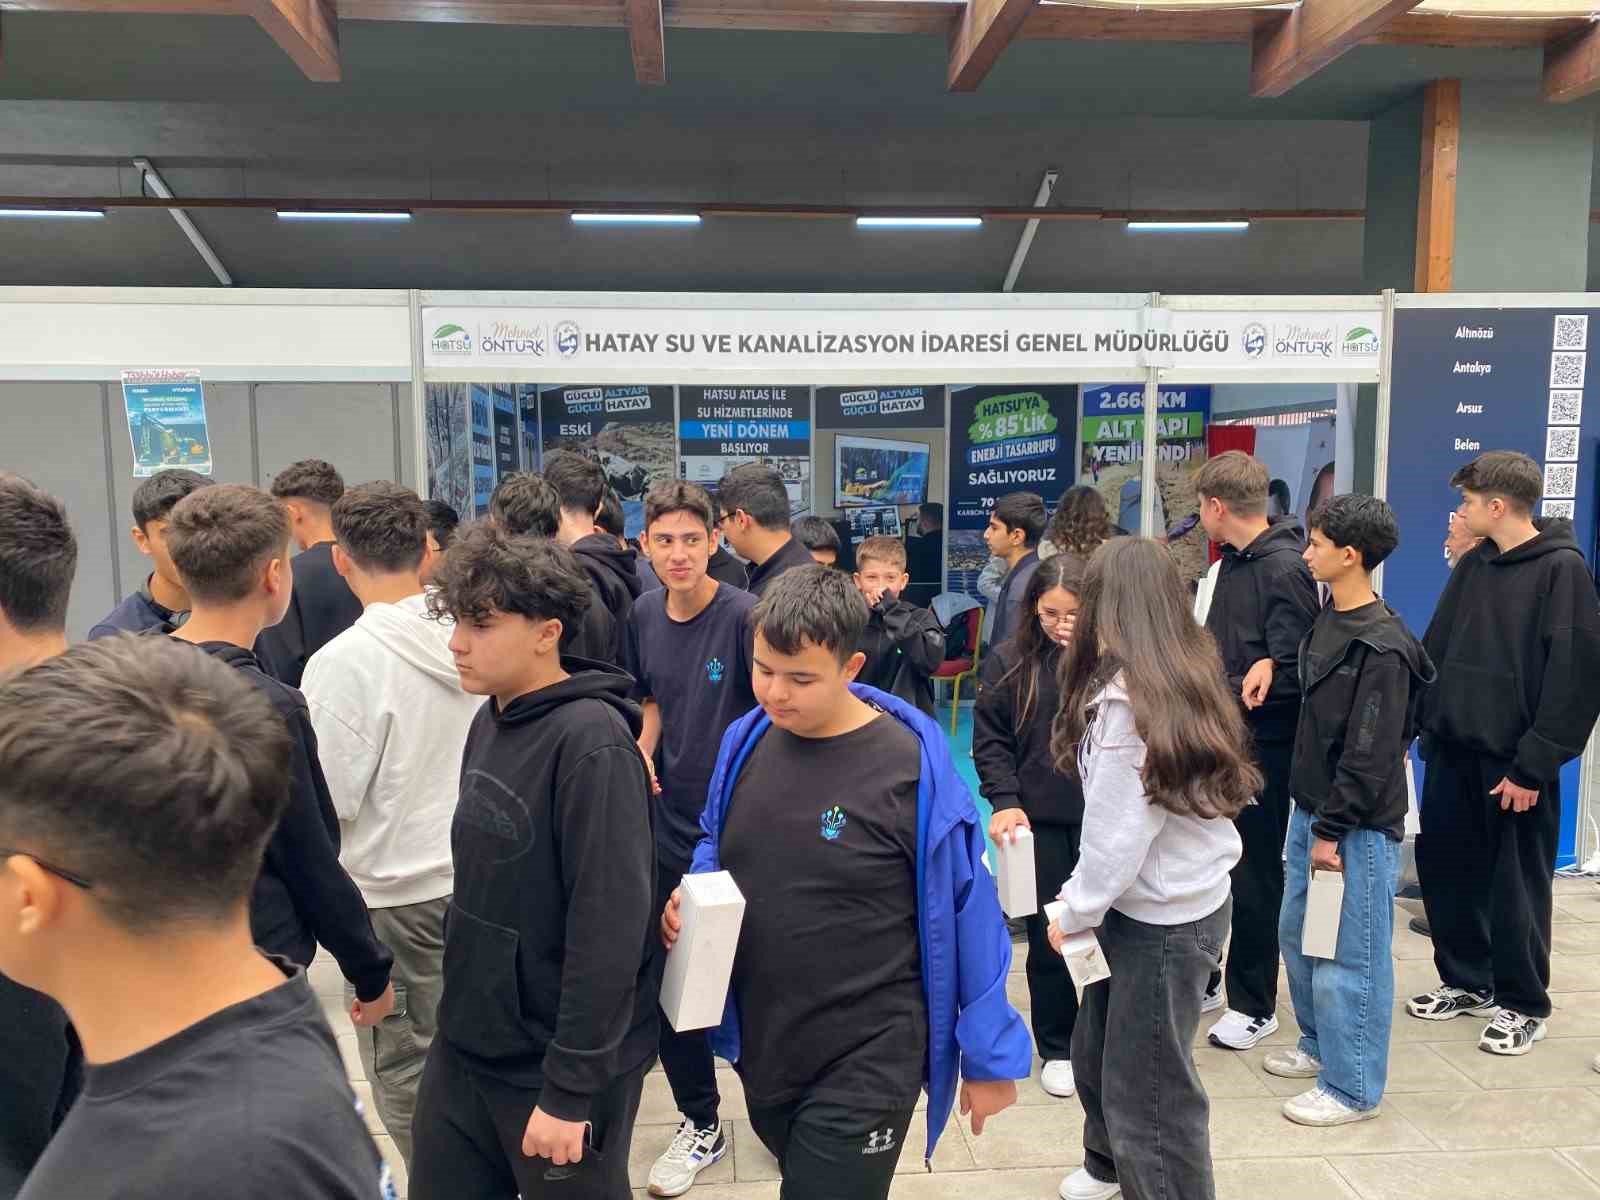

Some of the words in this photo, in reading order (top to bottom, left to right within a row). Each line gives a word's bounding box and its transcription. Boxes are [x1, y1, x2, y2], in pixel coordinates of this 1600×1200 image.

[1455, 326, 1494, 339] Altınözü
[585, 334, 658, 352] HATAY
[666, 334, 695, 353] SU
[702, 334, 732, 352] VE
[738, 330, 915, 353] KANALİZASYON
[921, 330, 1009, 353] İDARESİ
[1016, 334, 1088, 351] GENEL
[1095, 329, 1229, 352] MÜDÜRLÜĞÜ
[1453, 360, 1492, 376] Antakya
[703, 389, 736, 400] HATSU
[740, 389, 769, 400] ATLAS
[772, 387, 786, 400] İLE
[607, 399, 648, 411] HATAY
[697, 407, 711, 418] SU
[714, 404, 793, 418] HİZMETLERİNDE
[881, 401, 921, 411] HATAY
[983, 397, 1040, 416] HATSU'YA
[1456, 401, 1483, 414] Arsuz
[560, 422, 592, 435] ESKİ
[702, 421, 733, 438] YENİ
[738, 421, 789, 438] DÖNEM
[1097, 420, 1136, 439] ALT
[1143, 416, 1190, 438] API
[721, 443, 769, 456] BAŞLIYOR
[971, 444, 1003, 463] ENERJİ
[1006, 438, 1056, 458] TASARRUFU
[1454, 438, 1480, 451] Belen
[1093, 441, 1191, 462] YENİLNDİ
[969, 468, 1056, 485] SAĞLIYORUZ
[980, 497, 995, 508] 70
